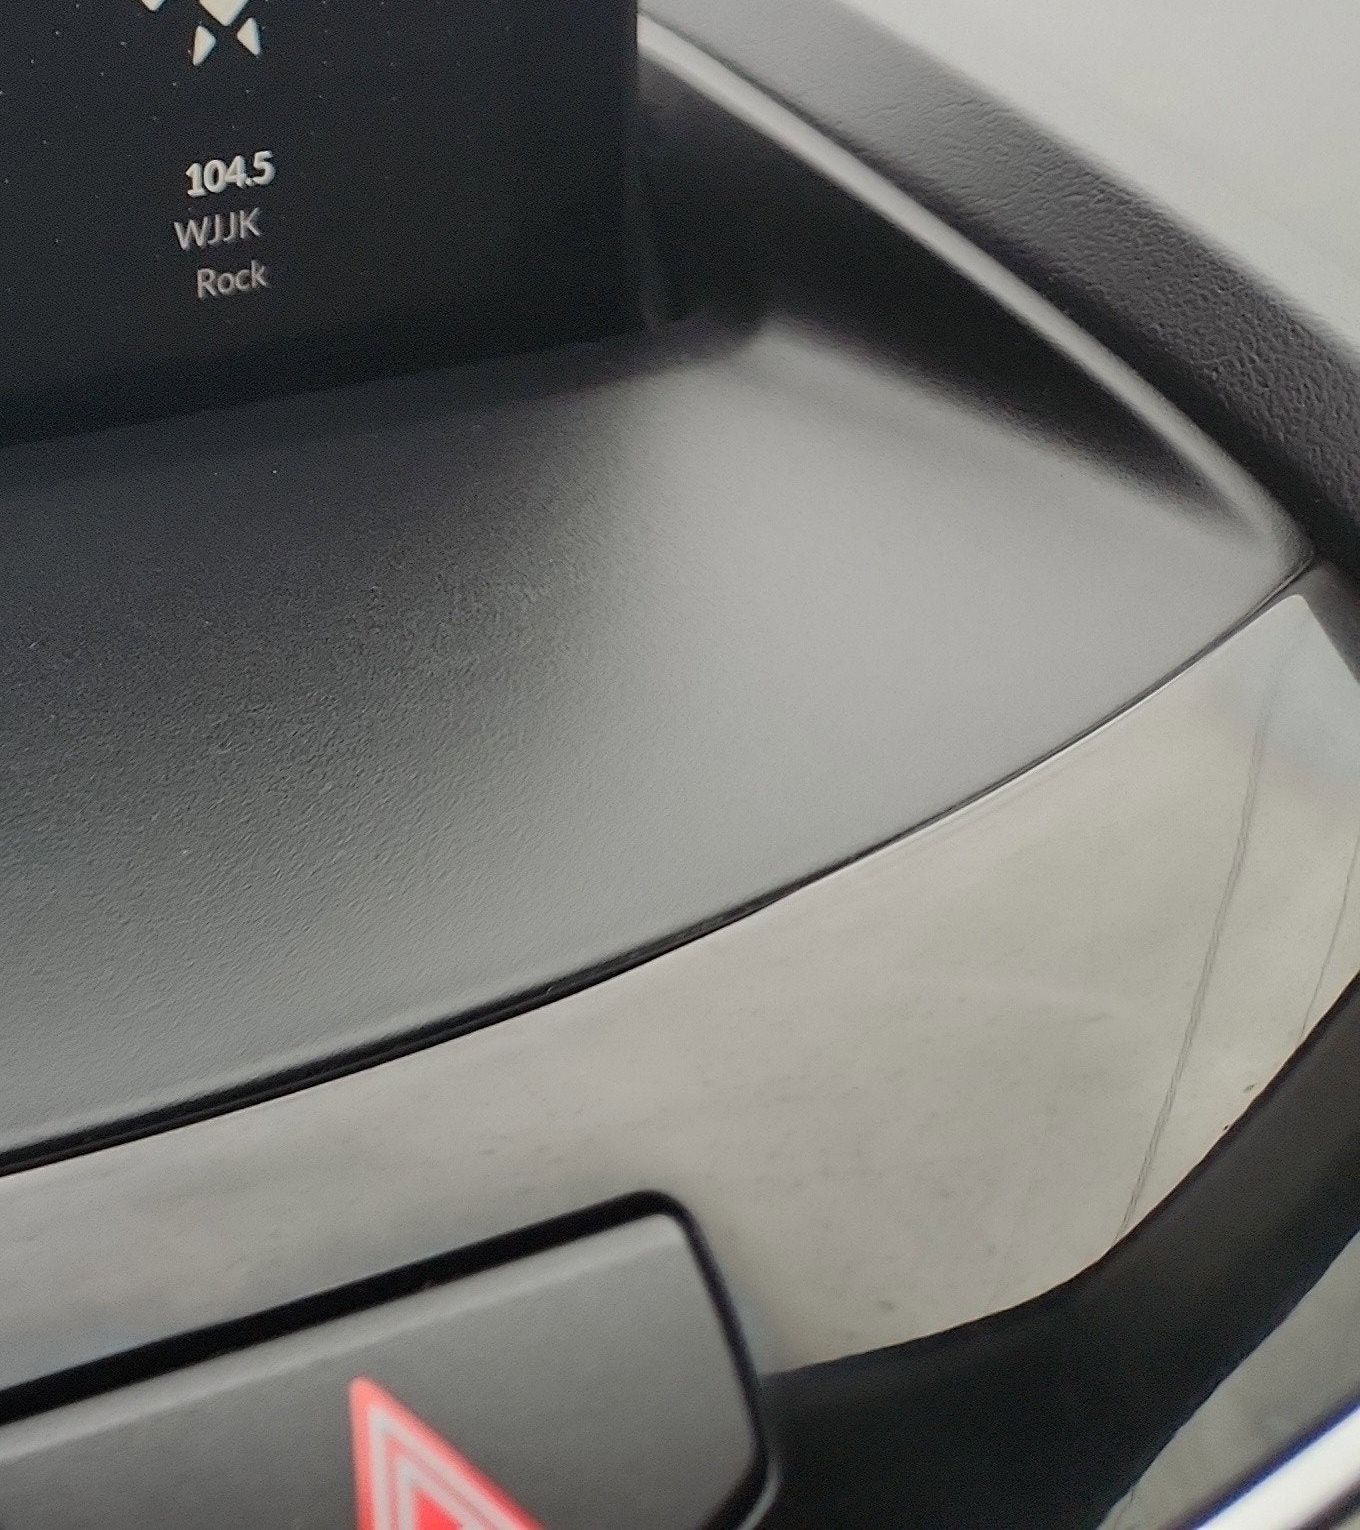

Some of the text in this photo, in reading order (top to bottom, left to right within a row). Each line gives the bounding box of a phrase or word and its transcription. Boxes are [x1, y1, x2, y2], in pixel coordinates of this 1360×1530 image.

[185, 150, 275, 197] 104.5
[173, 207, 261, 250] WJJK
[196, 260, 268, 299] Rock
